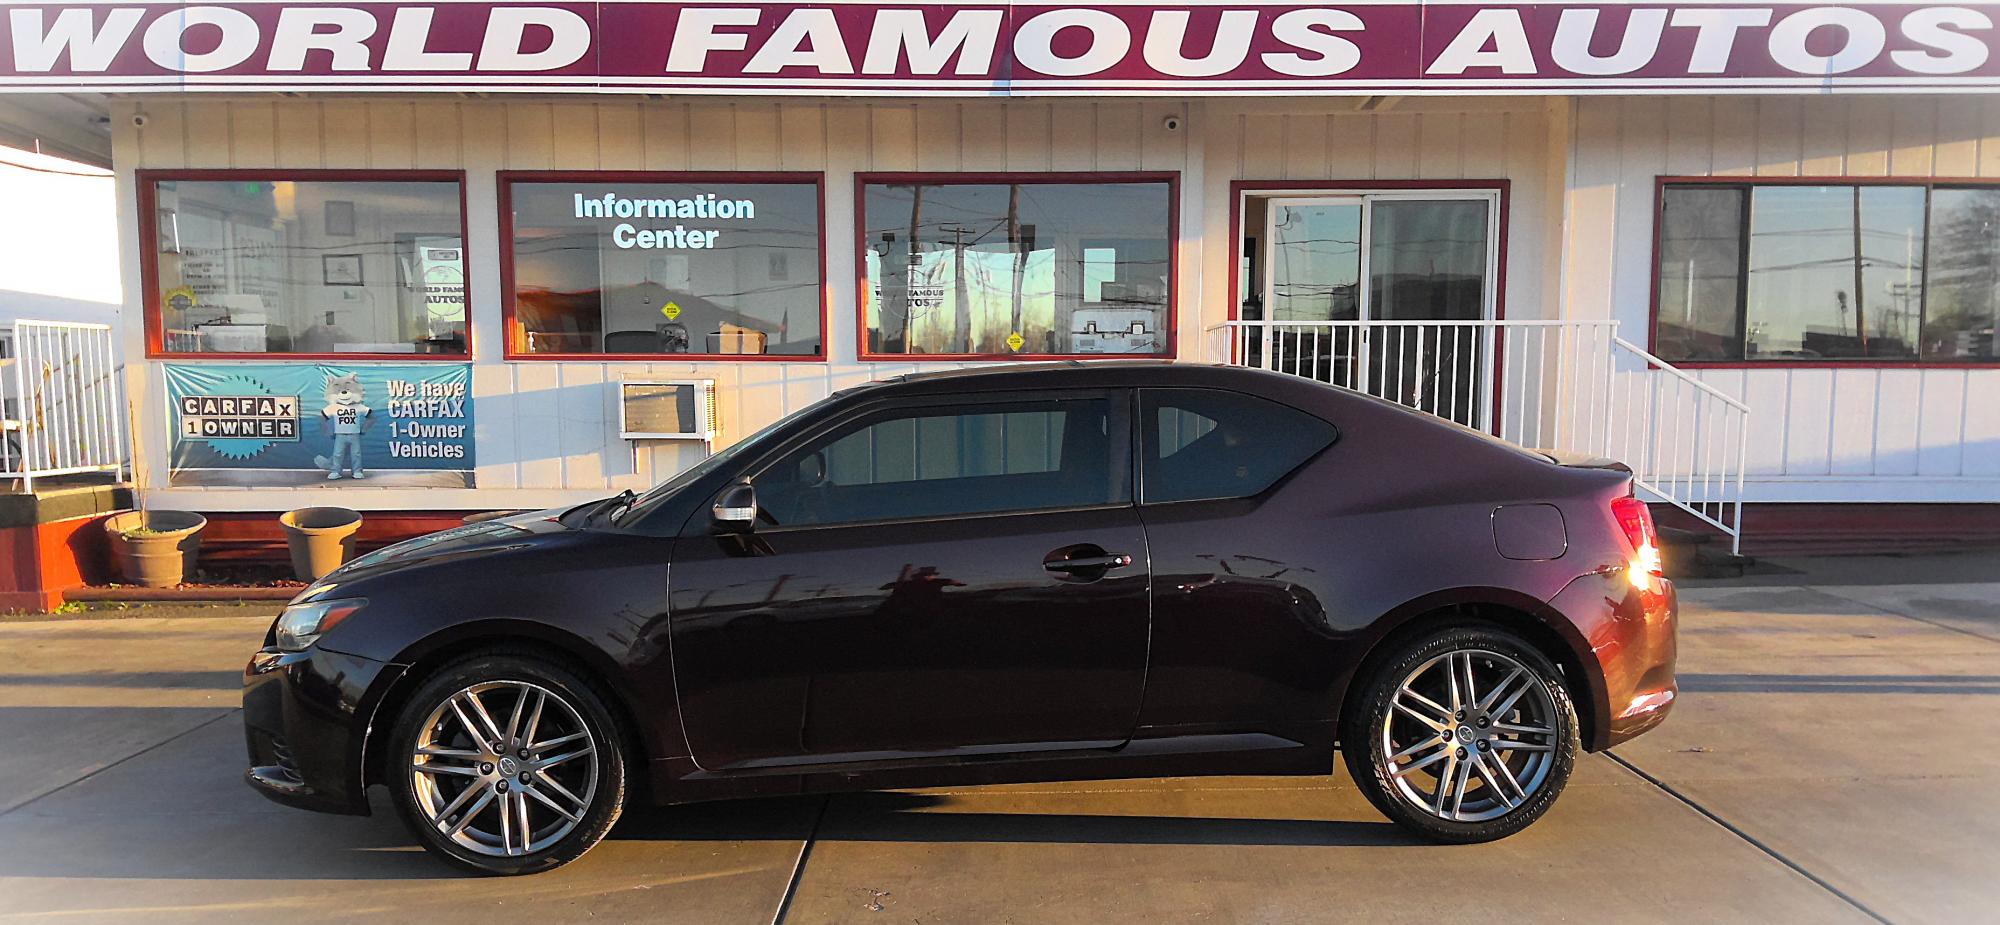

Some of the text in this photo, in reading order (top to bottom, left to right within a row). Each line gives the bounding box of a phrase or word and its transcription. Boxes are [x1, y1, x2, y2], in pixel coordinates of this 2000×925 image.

[8, 6, 1994, 77] WORLD FAMOUS AUTOS
[574, 193, 755, 219] Information
[613, 223, 720, 249] Center
[387, 380, 465, 397] We have
[184, 398, 292, 417] CARFAX
[336, 408, 357, 417] CAR
[387, 399, 465, 418] CARFAX
[187, 420, 293, 436] 1 OWNER
[338, 416, 356, 425] FOX
[388, 421, 466, 439] 1-Owner
[388, 440, 465, 458] Vehicles
